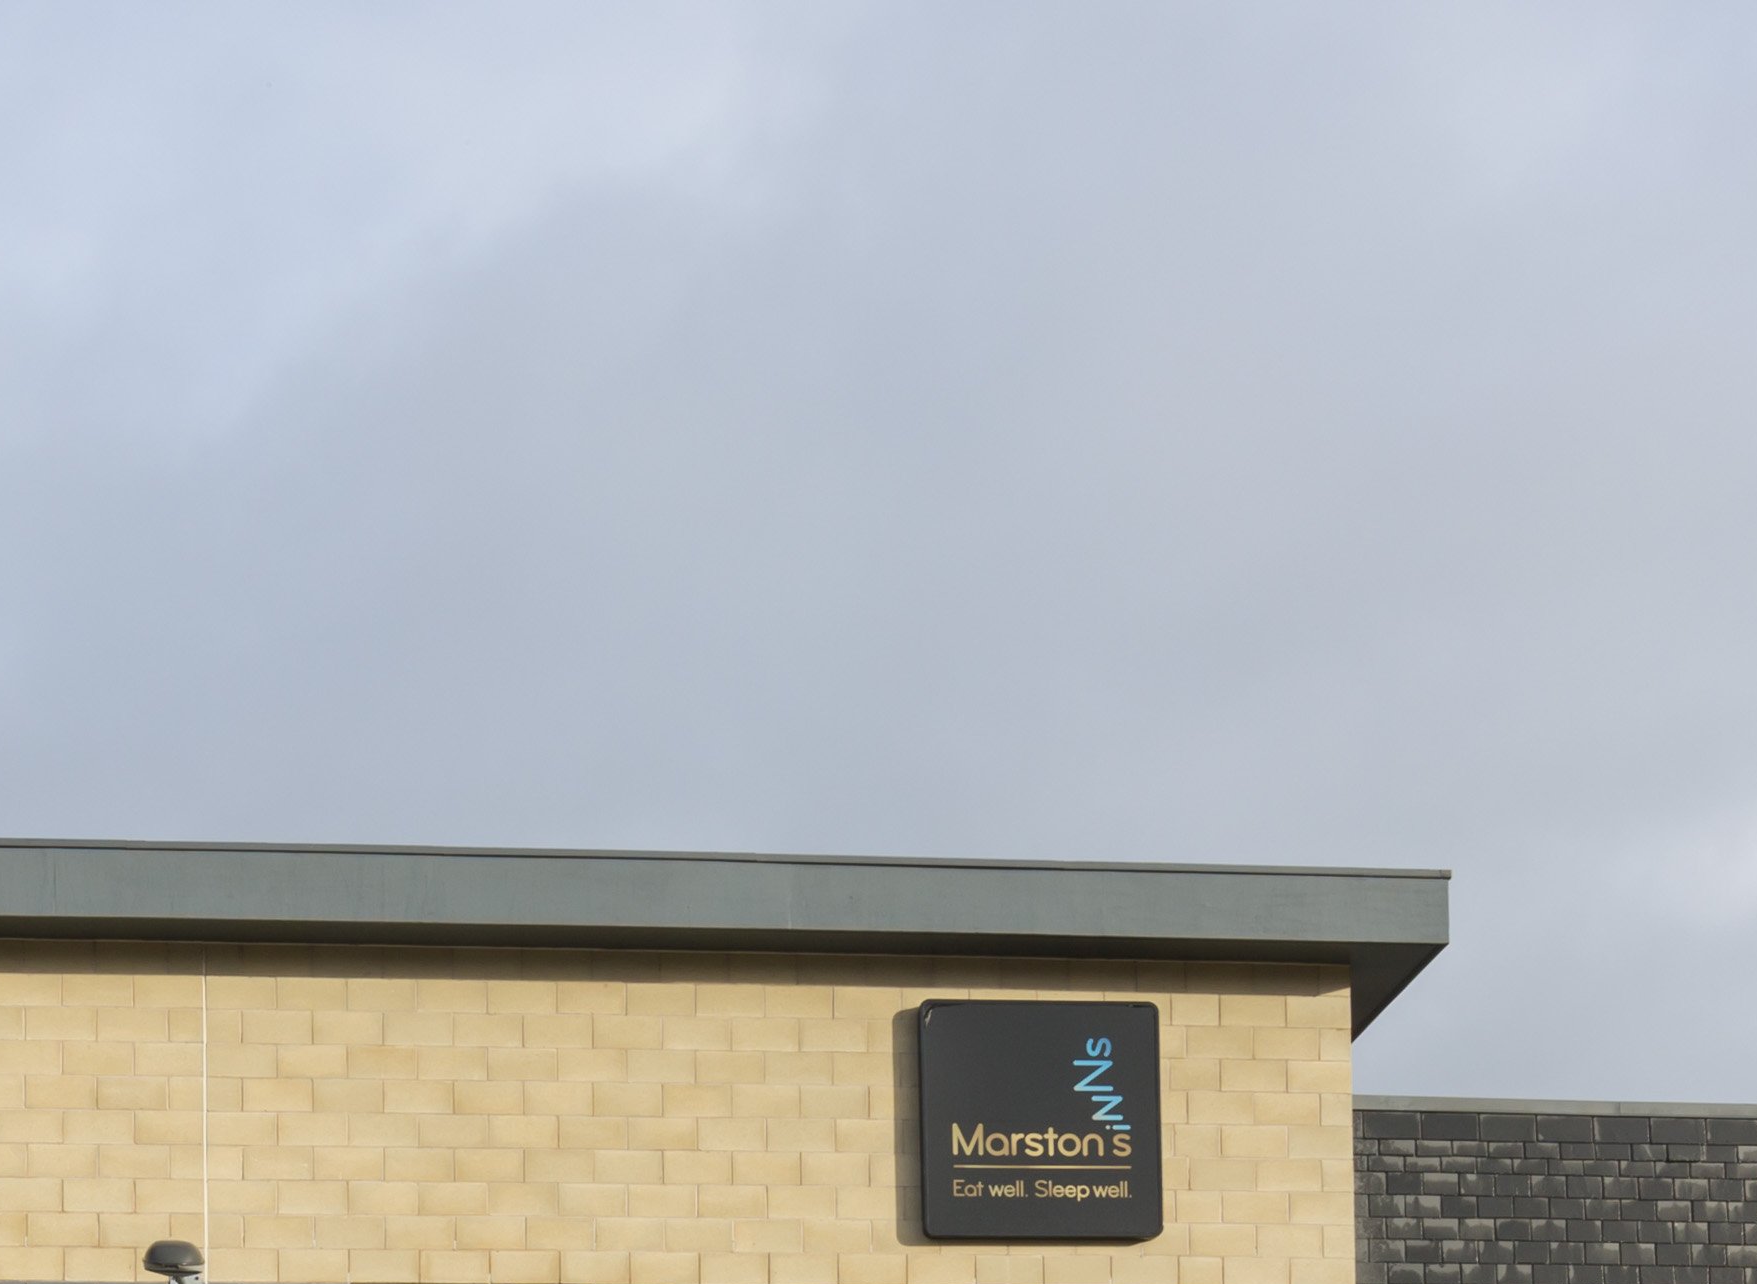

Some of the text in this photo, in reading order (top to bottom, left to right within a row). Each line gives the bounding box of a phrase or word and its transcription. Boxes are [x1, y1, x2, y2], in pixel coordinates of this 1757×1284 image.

[953, 1179, 1133, 1202] Eat well. Sleep well.
